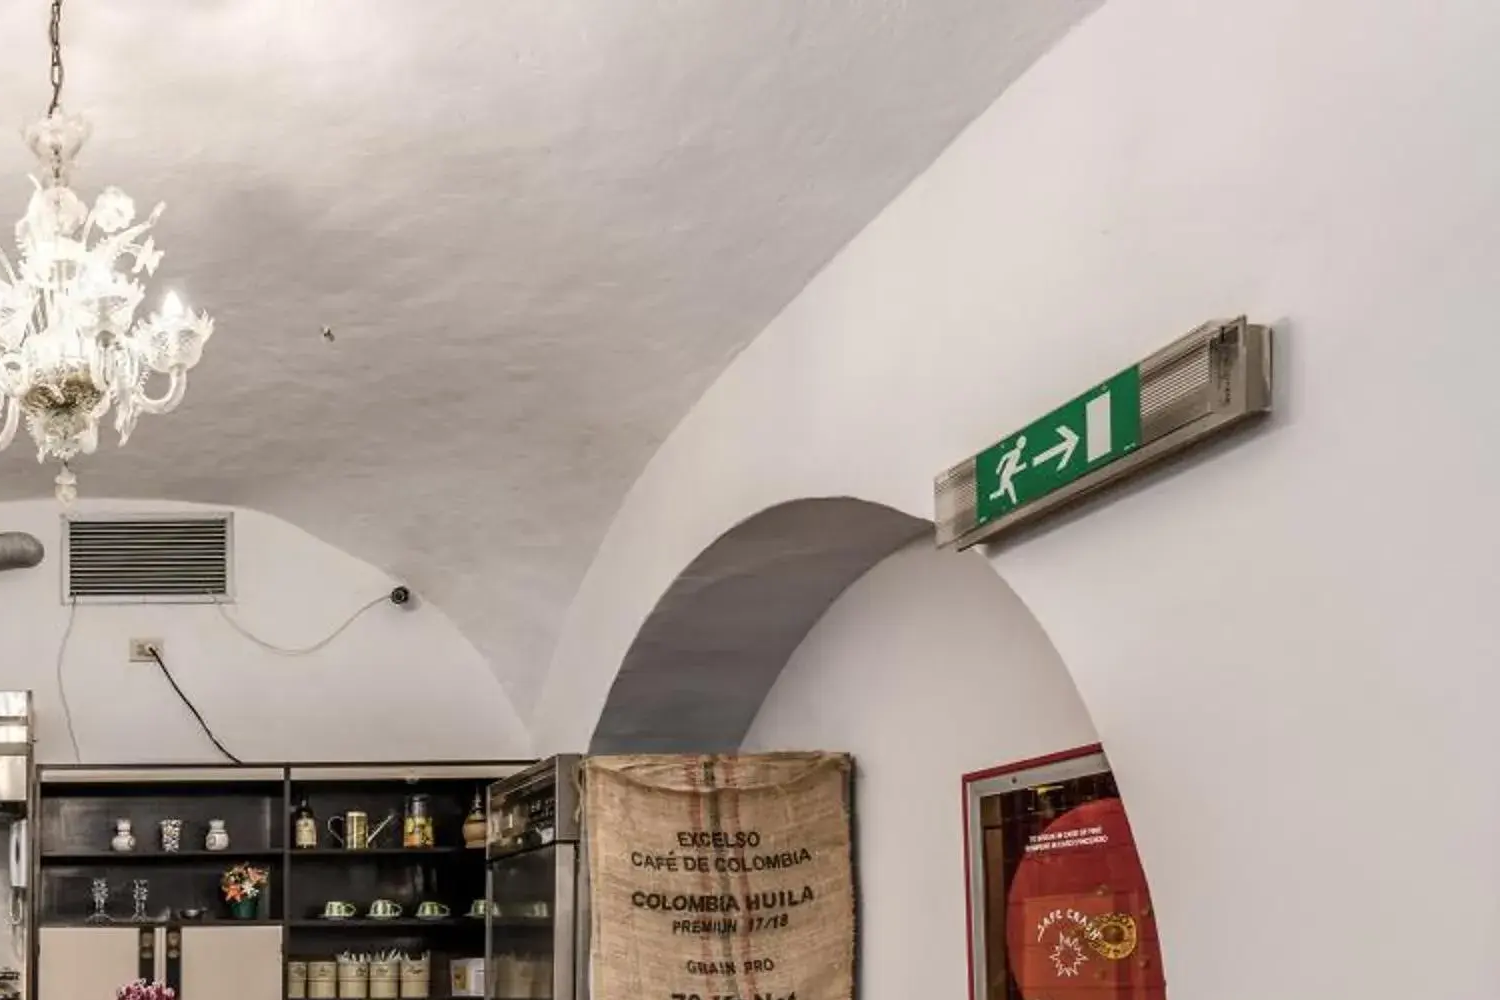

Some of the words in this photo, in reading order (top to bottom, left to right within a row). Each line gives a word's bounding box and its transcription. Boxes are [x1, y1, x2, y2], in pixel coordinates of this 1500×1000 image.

[677, 831, 761, 848] EXCELSO
[631, 849, 678, 872] CAFÉ
[684, 857, 710, 872] DE
[715, 847, 812, 873] COLOMBIA
[631, 891, 740, 912] COLOMBIA
[746, 885, 814, 911] HUILA
[743, 958, 774, 975] PRO
